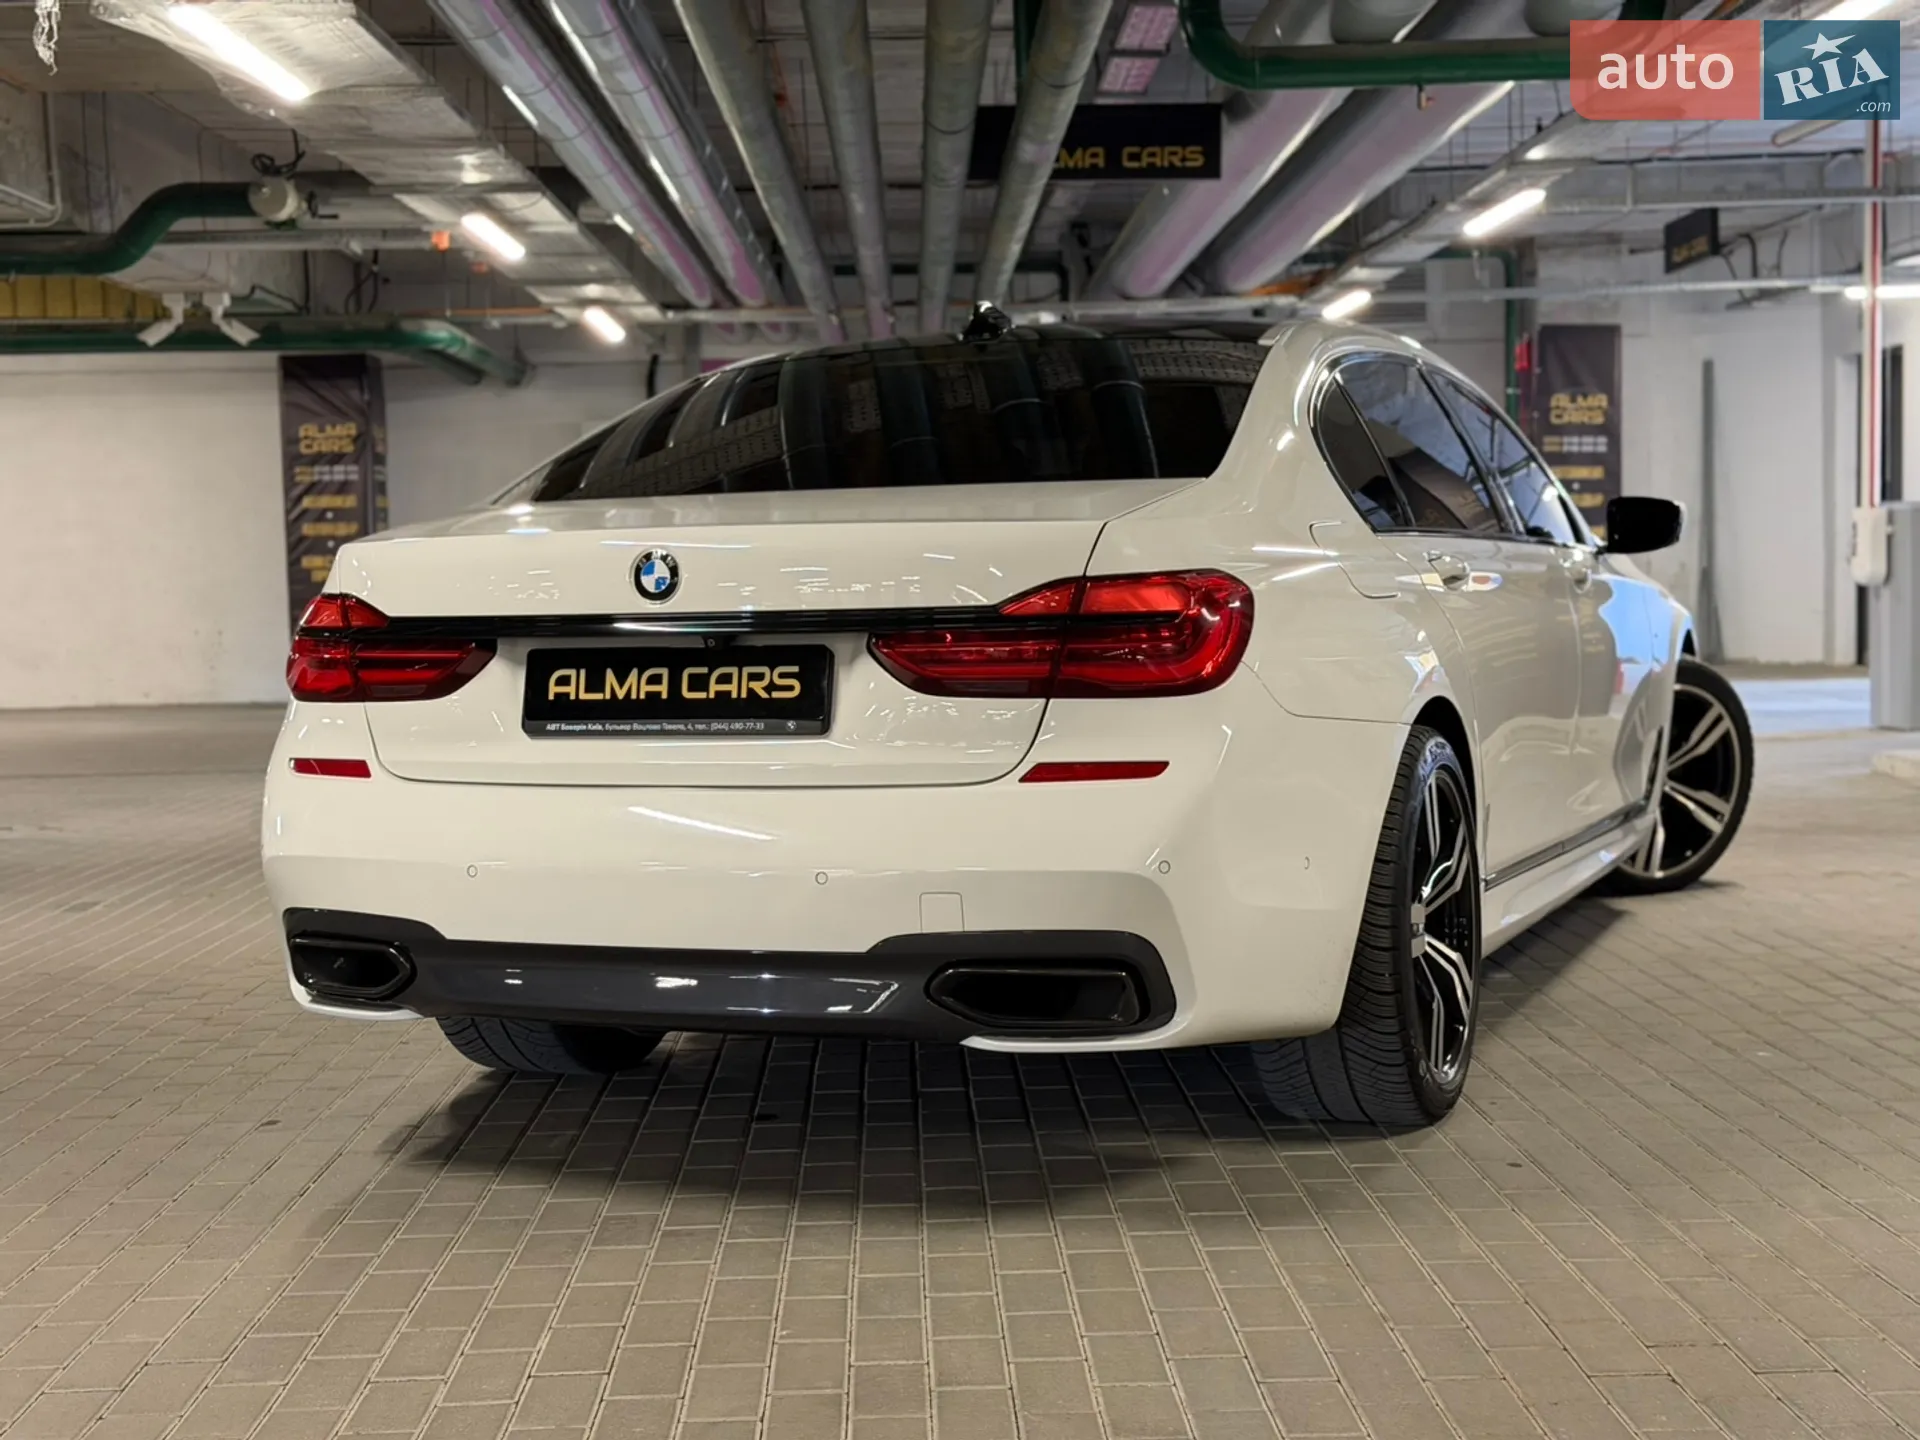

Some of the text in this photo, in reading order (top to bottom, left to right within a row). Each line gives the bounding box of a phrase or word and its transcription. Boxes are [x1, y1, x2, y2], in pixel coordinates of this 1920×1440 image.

[1121, 146, 1205, 168] CARS
[547, 665, 802, 701] ALMA CARS
